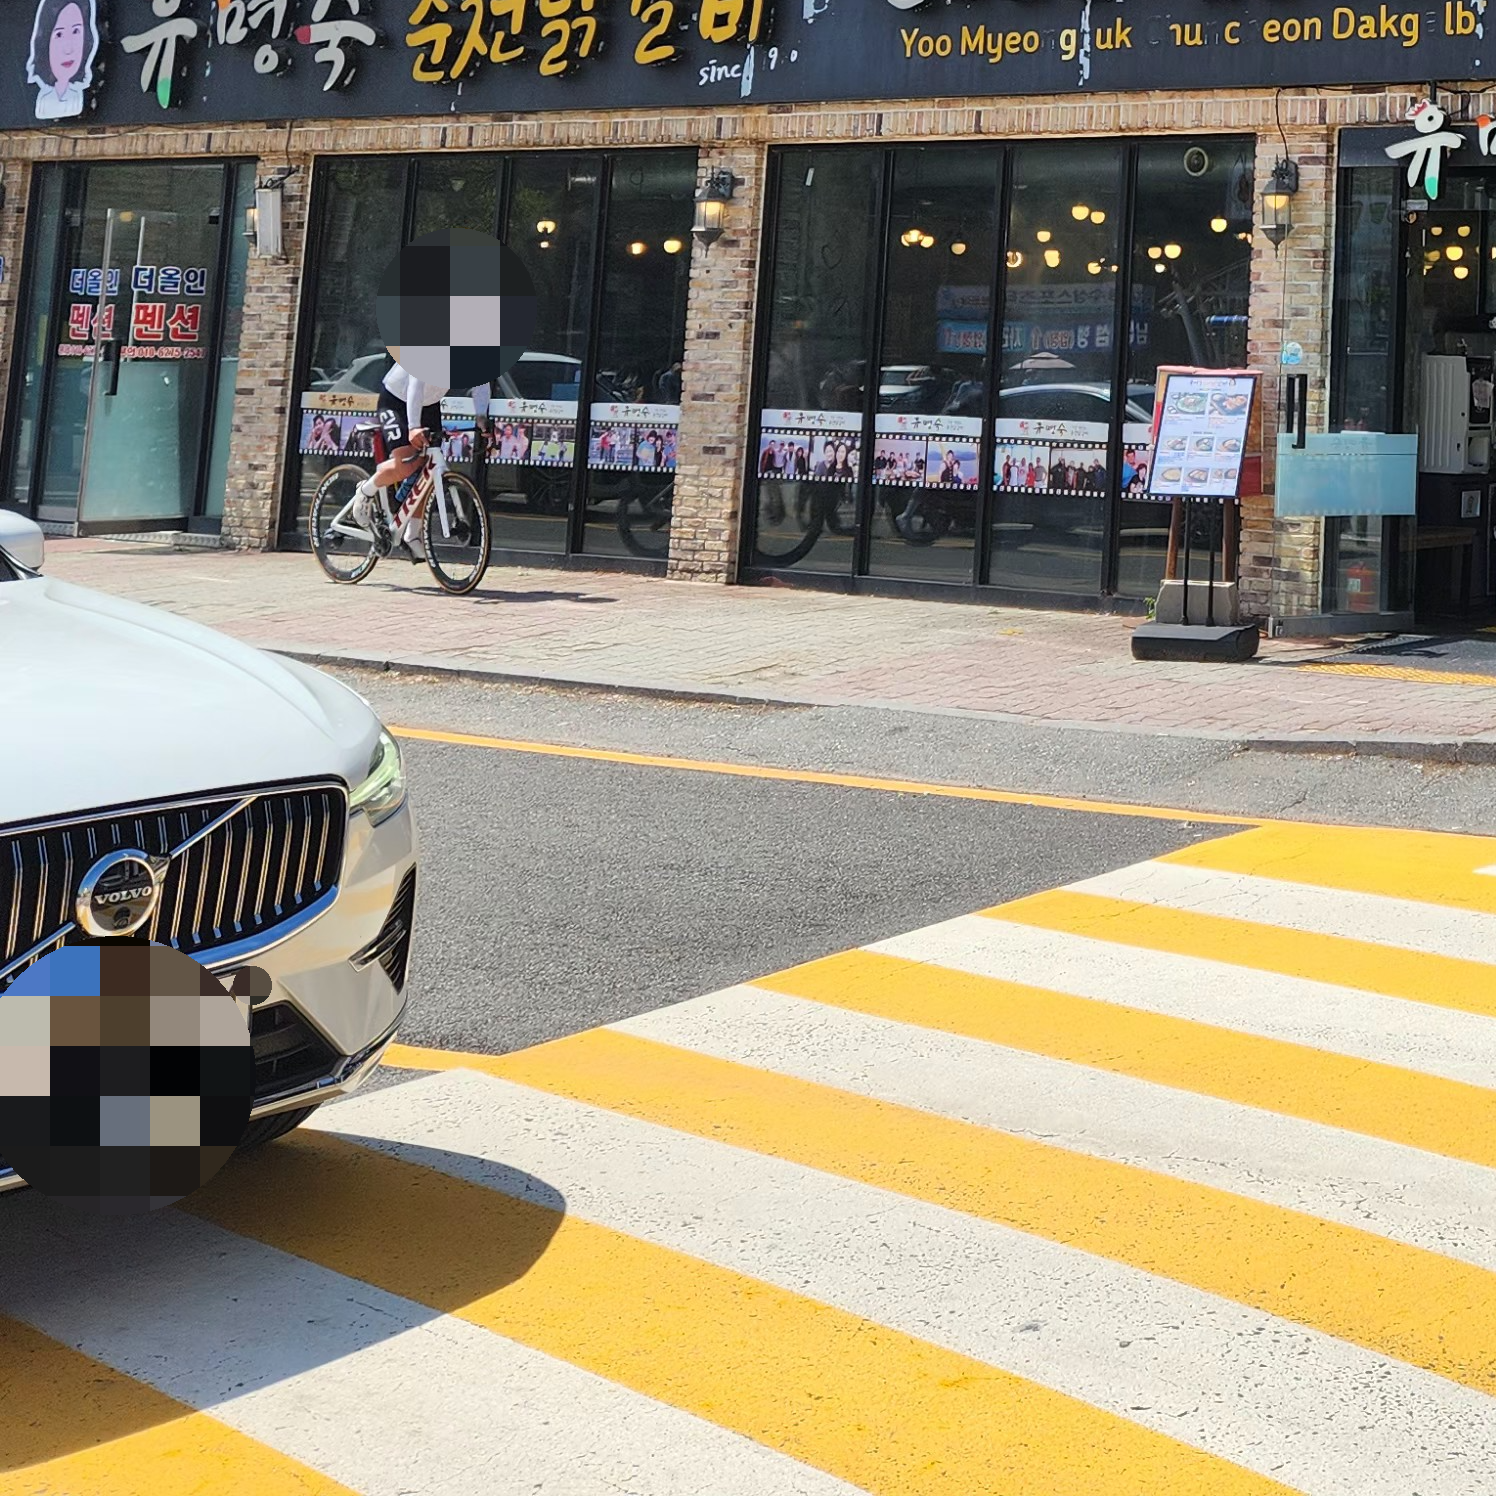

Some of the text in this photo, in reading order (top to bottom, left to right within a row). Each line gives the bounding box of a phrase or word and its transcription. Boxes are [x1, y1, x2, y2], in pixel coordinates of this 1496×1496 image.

[901, 27, 952, 58] Yoo
[960, 24, 1077, 64] Myeog
[1095, 17, 1133, 50] uk
[1331, 0, 1486, 48] Dakglb
[698, 59, 743, 87] sinc
[69, 268, 120, 296] 더올인
[131, 265, 207, 296] 더올인
[133, 302, 202, 342] 펜션
[393, 453, 437, 529] TREK
[94, 885, 153, 905] VOLVO
